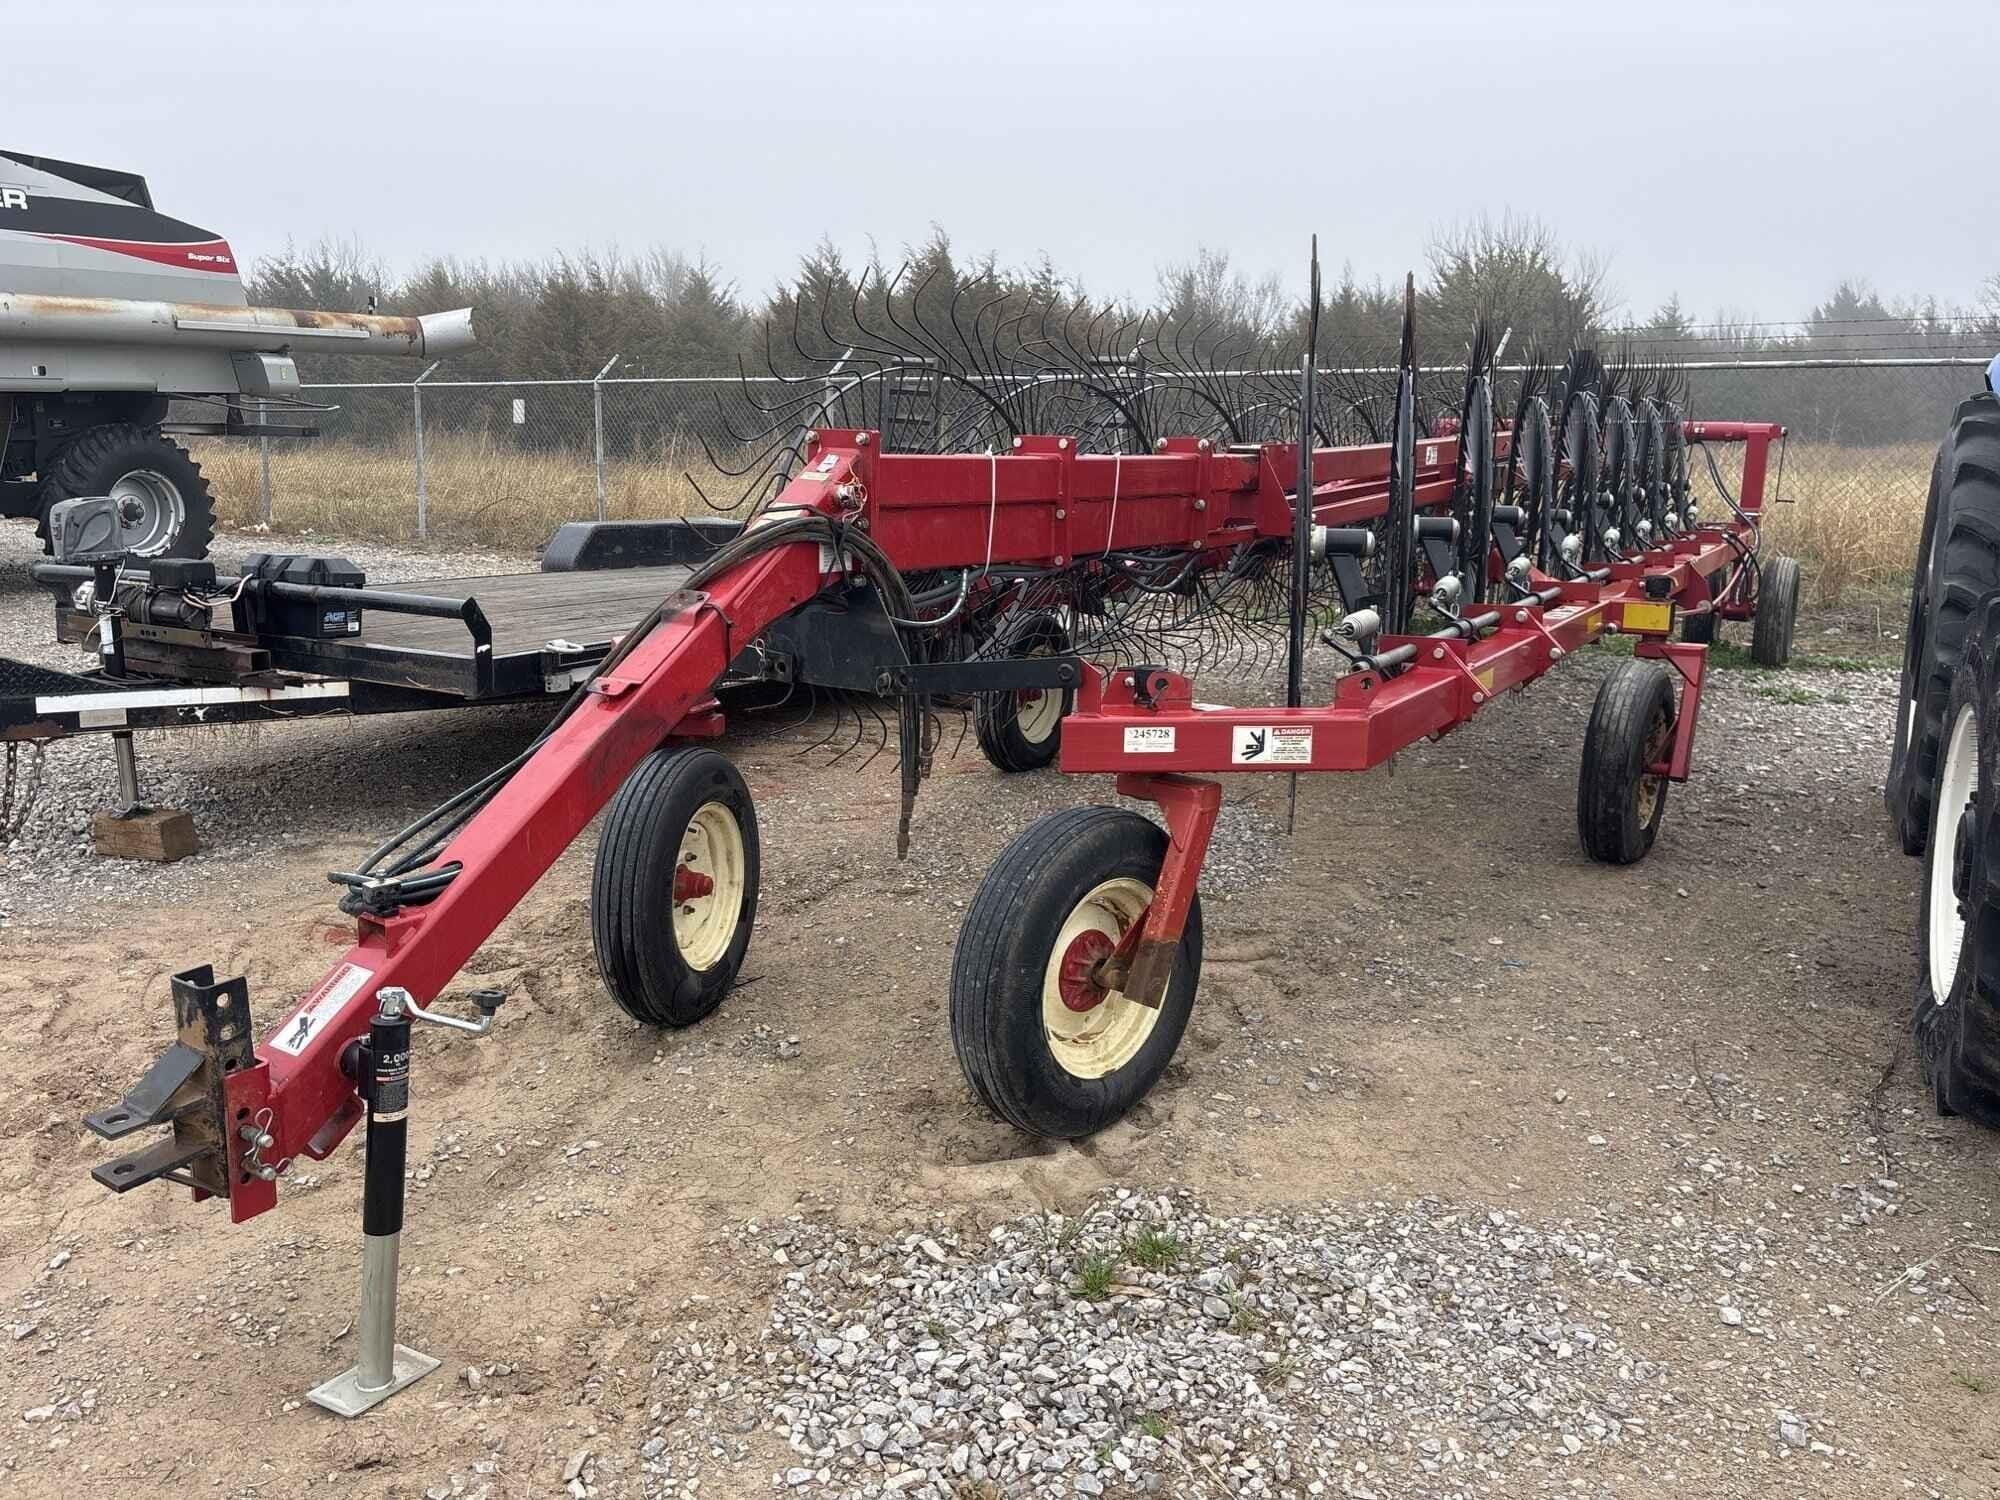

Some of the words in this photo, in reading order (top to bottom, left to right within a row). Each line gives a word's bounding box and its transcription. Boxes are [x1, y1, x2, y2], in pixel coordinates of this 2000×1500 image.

[187, 252, 214, 262] Super
[215, 255, 231, 263] Six
[1133, 729, 1170, 738] 245728
[312, 965, 352, 1004] WARNING
